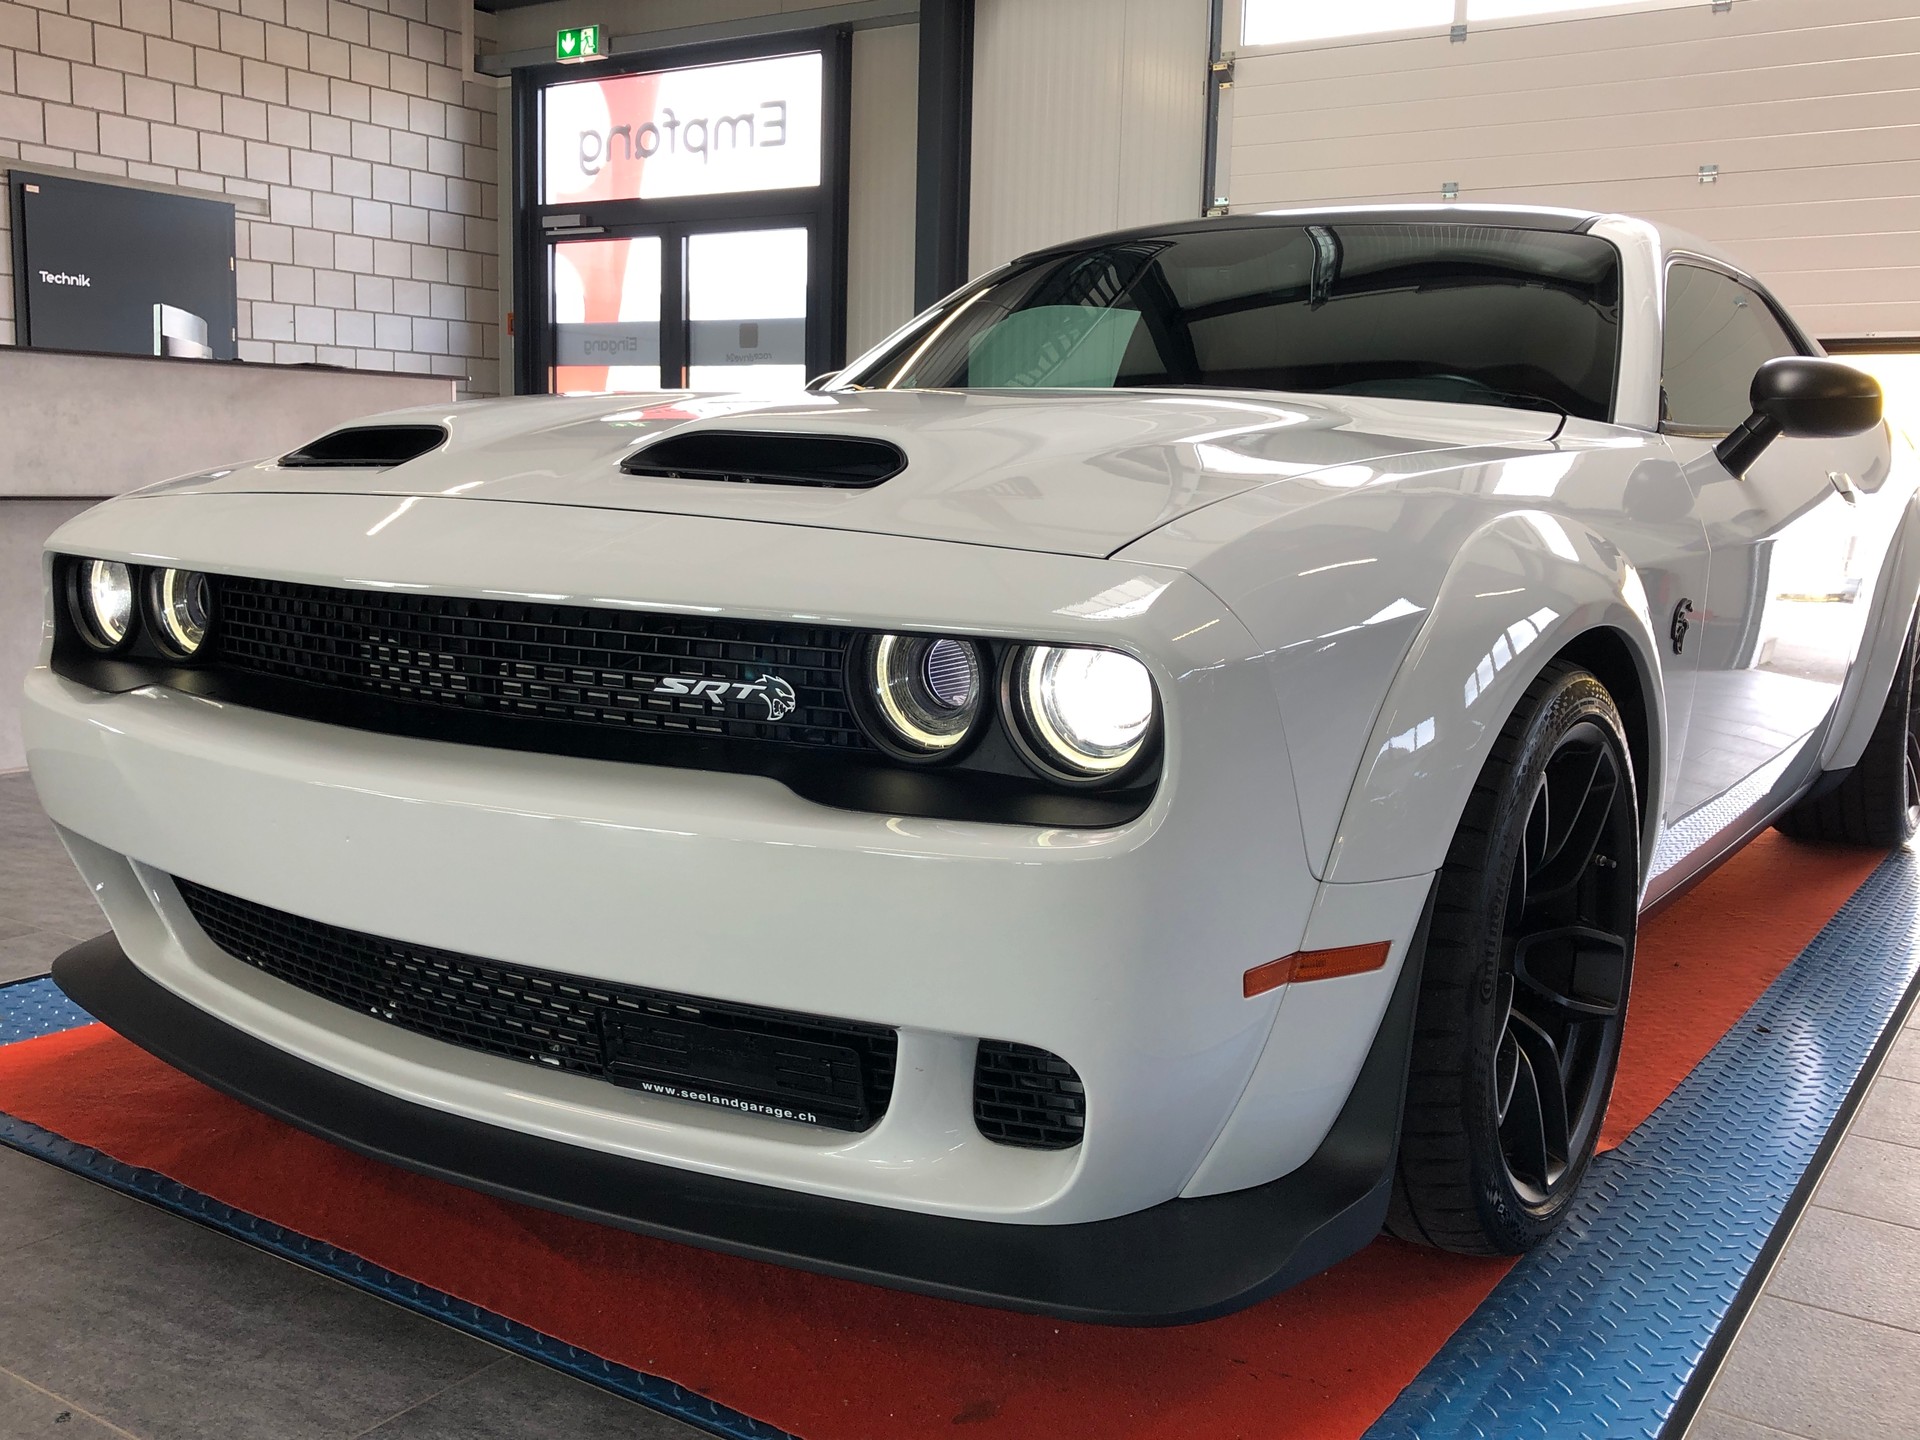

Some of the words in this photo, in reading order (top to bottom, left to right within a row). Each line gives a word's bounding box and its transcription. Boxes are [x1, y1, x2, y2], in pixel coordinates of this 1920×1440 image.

[38, 270, 91, 287] Technik
[653, 677, 767, 704] SRT
[642, 1082, 817, 1123] www.seelandgarage.ch
